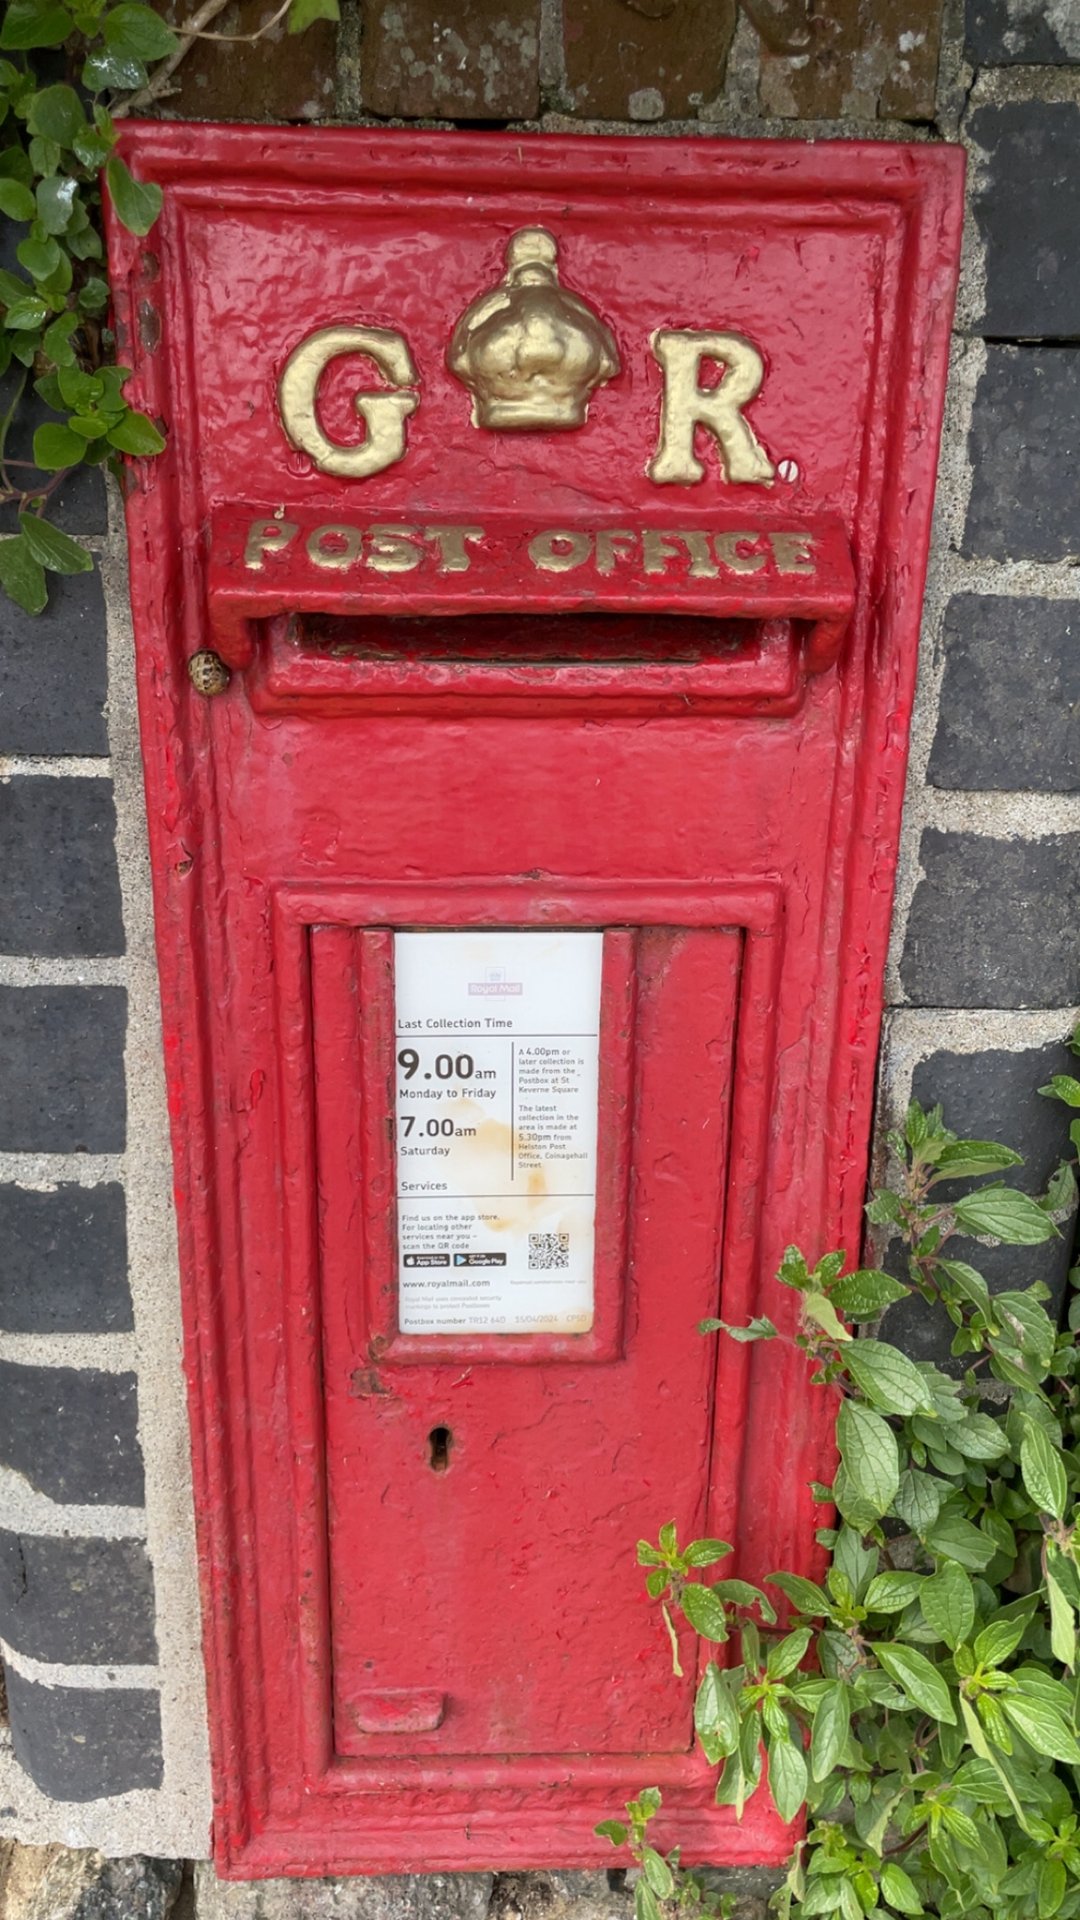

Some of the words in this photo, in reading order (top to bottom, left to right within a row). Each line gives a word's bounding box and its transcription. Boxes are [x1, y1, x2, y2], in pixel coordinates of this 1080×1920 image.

[277, 325, 421, 479] G
[243, 518, 486, 573] POST
[526, 528, 817, 579] OFFICE
[470, 984, 498, 994] Royal
[499, 984, 520, 993] Mail
[398, 1019, 422, 1028] Last
[426, 1019, 481, 1028] Collection
[485, 1018, 513, 1028] Time
[526, 1048, 559, 1056] 4.00pm
[400, 1089, 443, 1099] Monday
[462, 1089, 496, 1099] Friday
[519, 1133, 551, 1141] 5.30pm
[401, 1147, 450, 1156] Saturday
[545, 1152, 588, 1160] Coinagehall
[401, 1181, 447, 1190] Services
[402, 1280, 490, 1289] www.royalmail.com
